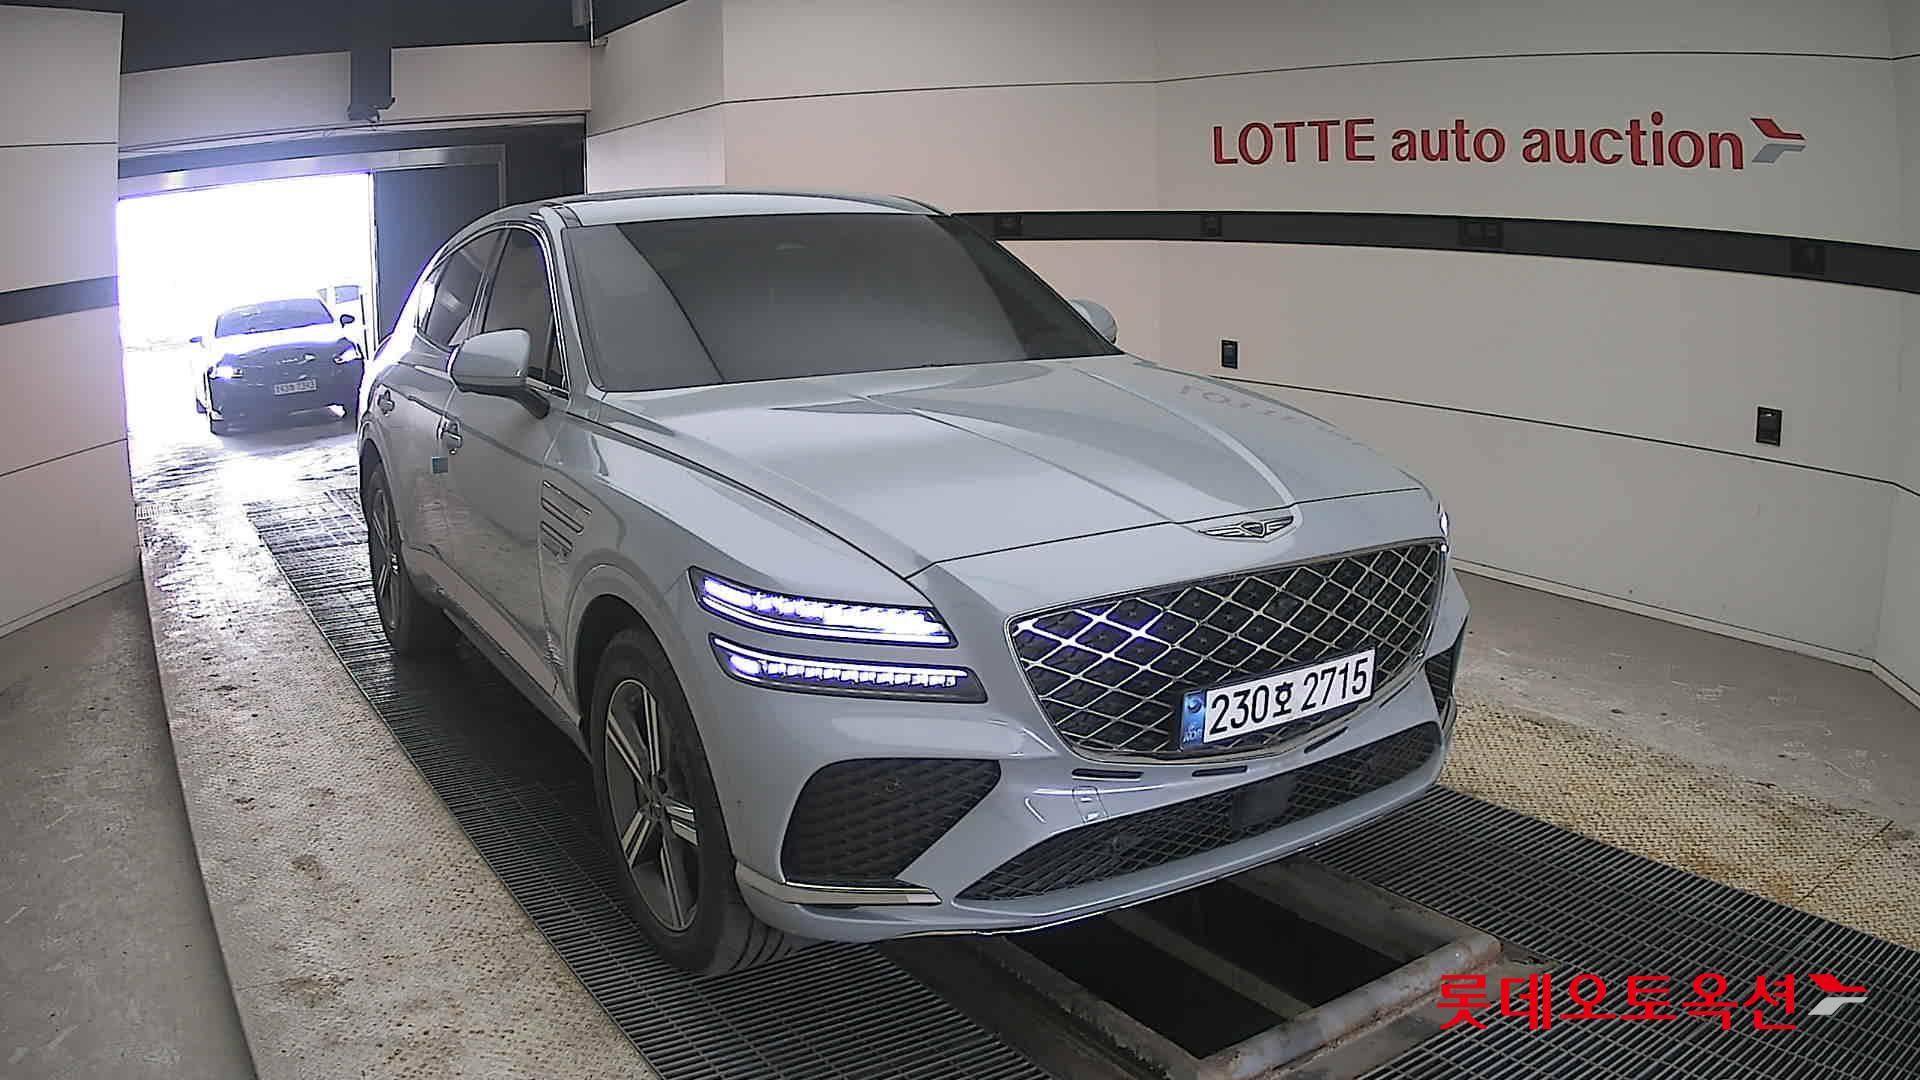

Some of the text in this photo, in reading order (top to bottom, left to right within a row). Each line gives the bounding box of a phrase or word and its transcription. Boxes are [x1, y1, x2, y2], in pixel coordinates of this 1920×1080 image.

[1213, 111, 1744, 169] LOTTE auto auction
[1210, 658, 1369, 735] 230호 2715
